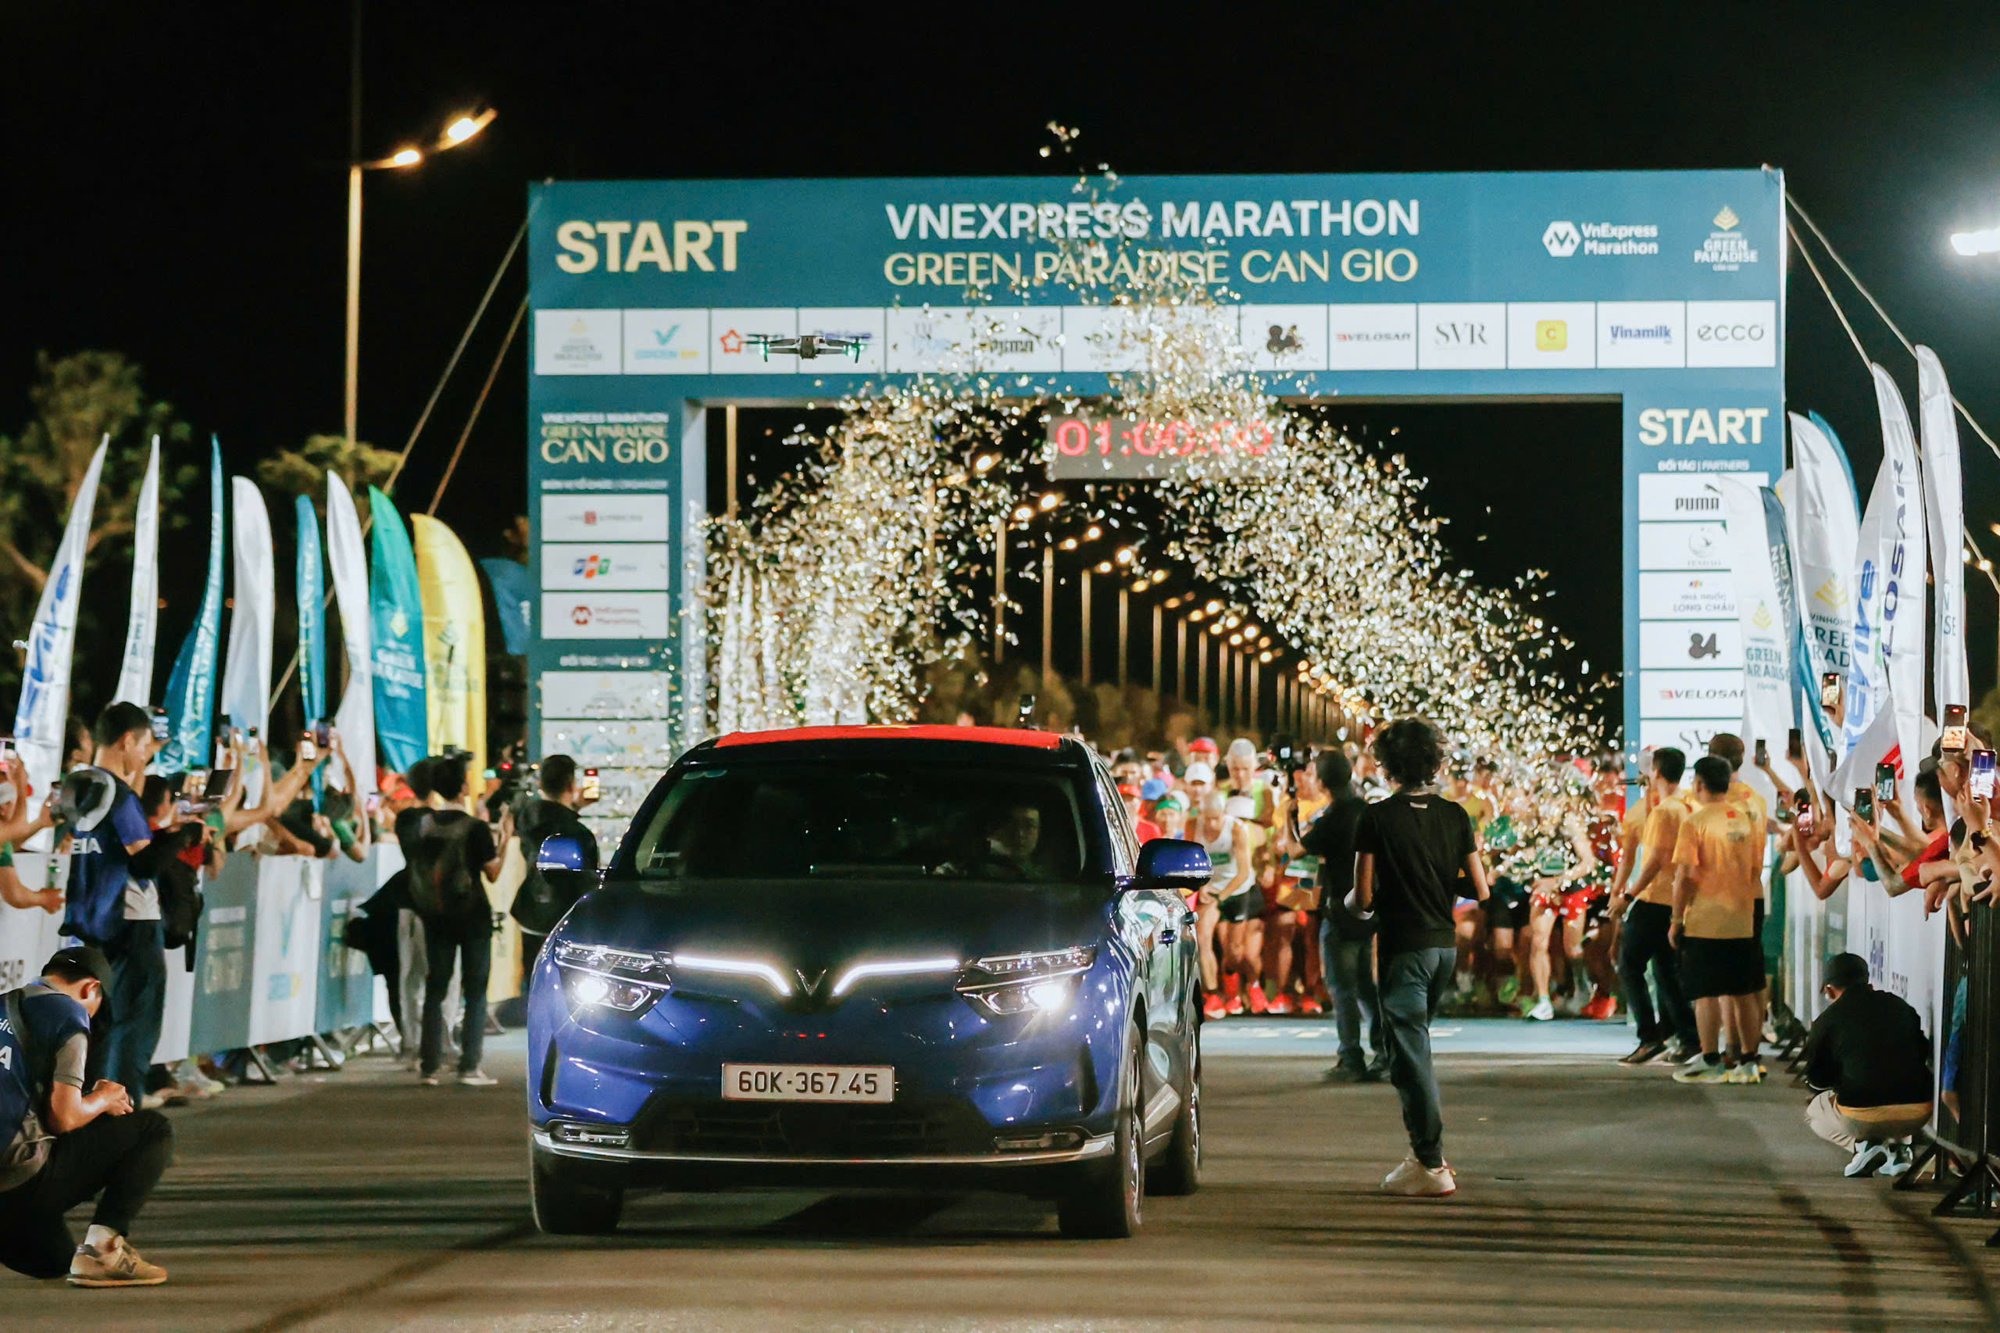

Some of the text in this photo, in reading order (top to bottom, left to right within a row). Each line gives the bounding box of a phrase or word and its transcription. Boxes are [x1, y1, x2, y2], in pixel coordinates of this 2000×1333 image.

[885, 199, 1420, 240] VNEXPRESS MARATHON
[1581, 221, 1659, 241] VnExpress
[556, 219, 748, 274] START
[1584, 239, 1659, 256] Marathon
[1693, 249, 1759, 264] PARADISE
[1703, 238, 1748, 252] GREEN
[883, 247, 1419, 286] GREEN PARADISE CAN GIO
[1434, 322, 1488, 346] SVR
[1610, 324, 1672, 340] Vinamilk
[1697, 323, 1765, 342] ecco
[1638, 407, 1769, 446] START
[541, 438, 670, 464] CAN GIO
[1674, 497, 1720, 512] PUMA
[1804, 624, 1850, 649] GREE
[738, 1070, 878, 1095] 60K-367.45
